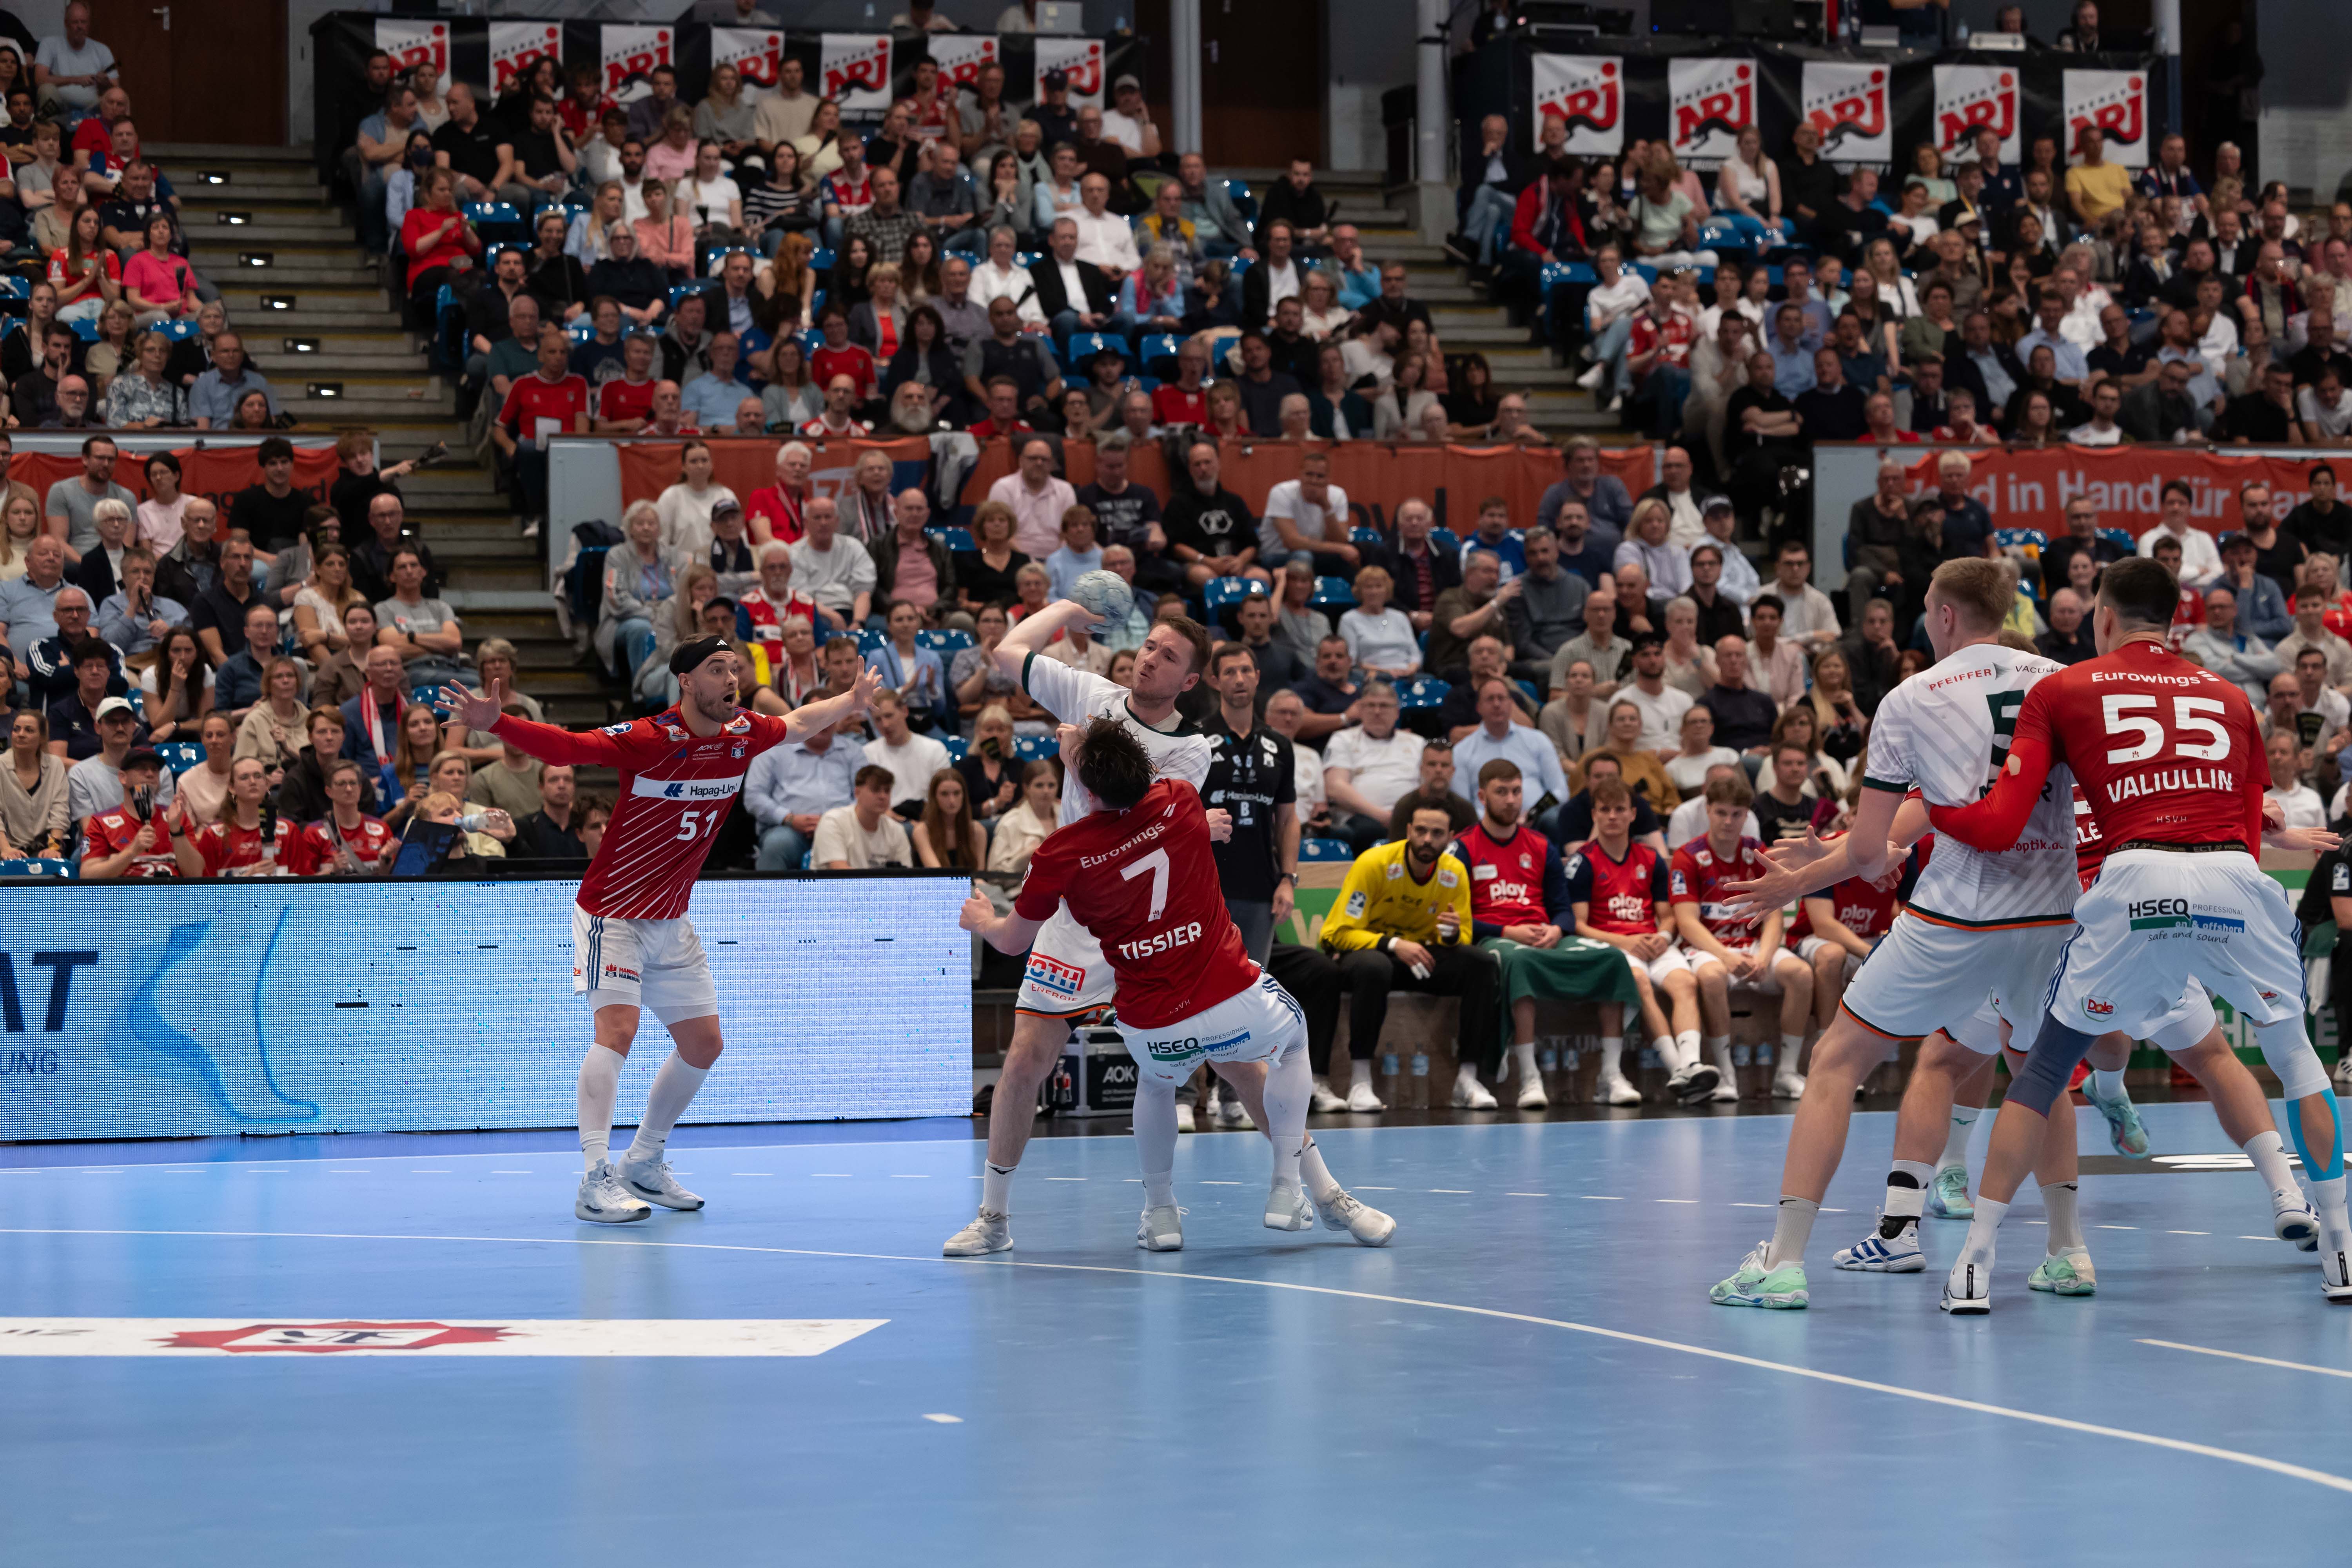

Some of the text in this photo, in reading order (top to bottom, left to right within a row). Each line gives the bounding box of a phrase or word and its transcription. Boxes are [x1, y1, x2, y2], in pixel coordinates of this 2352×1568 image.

[737, 35, 779, 86] RJ
[2008, 473, 2045, 513] in
[2179, 476, 2232, 517] ür
[1929, 668, 1992, 691] PFEIFFER
[2091, 671, 2201, 687] Eurowings
[2102, 694, 2231, 764] 55
[2106, 768, 2233, 803] VALIULLIN
[1240, 801, 1250, 817] B
[2157, 815, 2187, 823] HSVH
[677, 810, 718, 841] 51
[1080, 822, 1166, 869] Eurowings
[1120, 847, 1170, 922] 7
[1489, 879, 1527, 901] play
[1840, 904, 1877, 922] play
[2129, 898, 2245, 920] HSEQ PROFESSIONAL
[2148, 930, 2168, 942] safe
[2197, 934, 2229, 944] sound
[2202, 922, 2243, 933] offshore
[1118, 922, 1202, 960] TISSIER
[2088, 998, 2114, 1013] Dole
[1147, 1025, 1248, 1054] HSEQ PROFESSIONAL
[1213, 1037, 1249, 1053] offshore
[1191, 1054, 1207, 1063] and
[1210, 1048, 1238, 1057] sound
[1102, 1065, 1135, 1083] AOK
